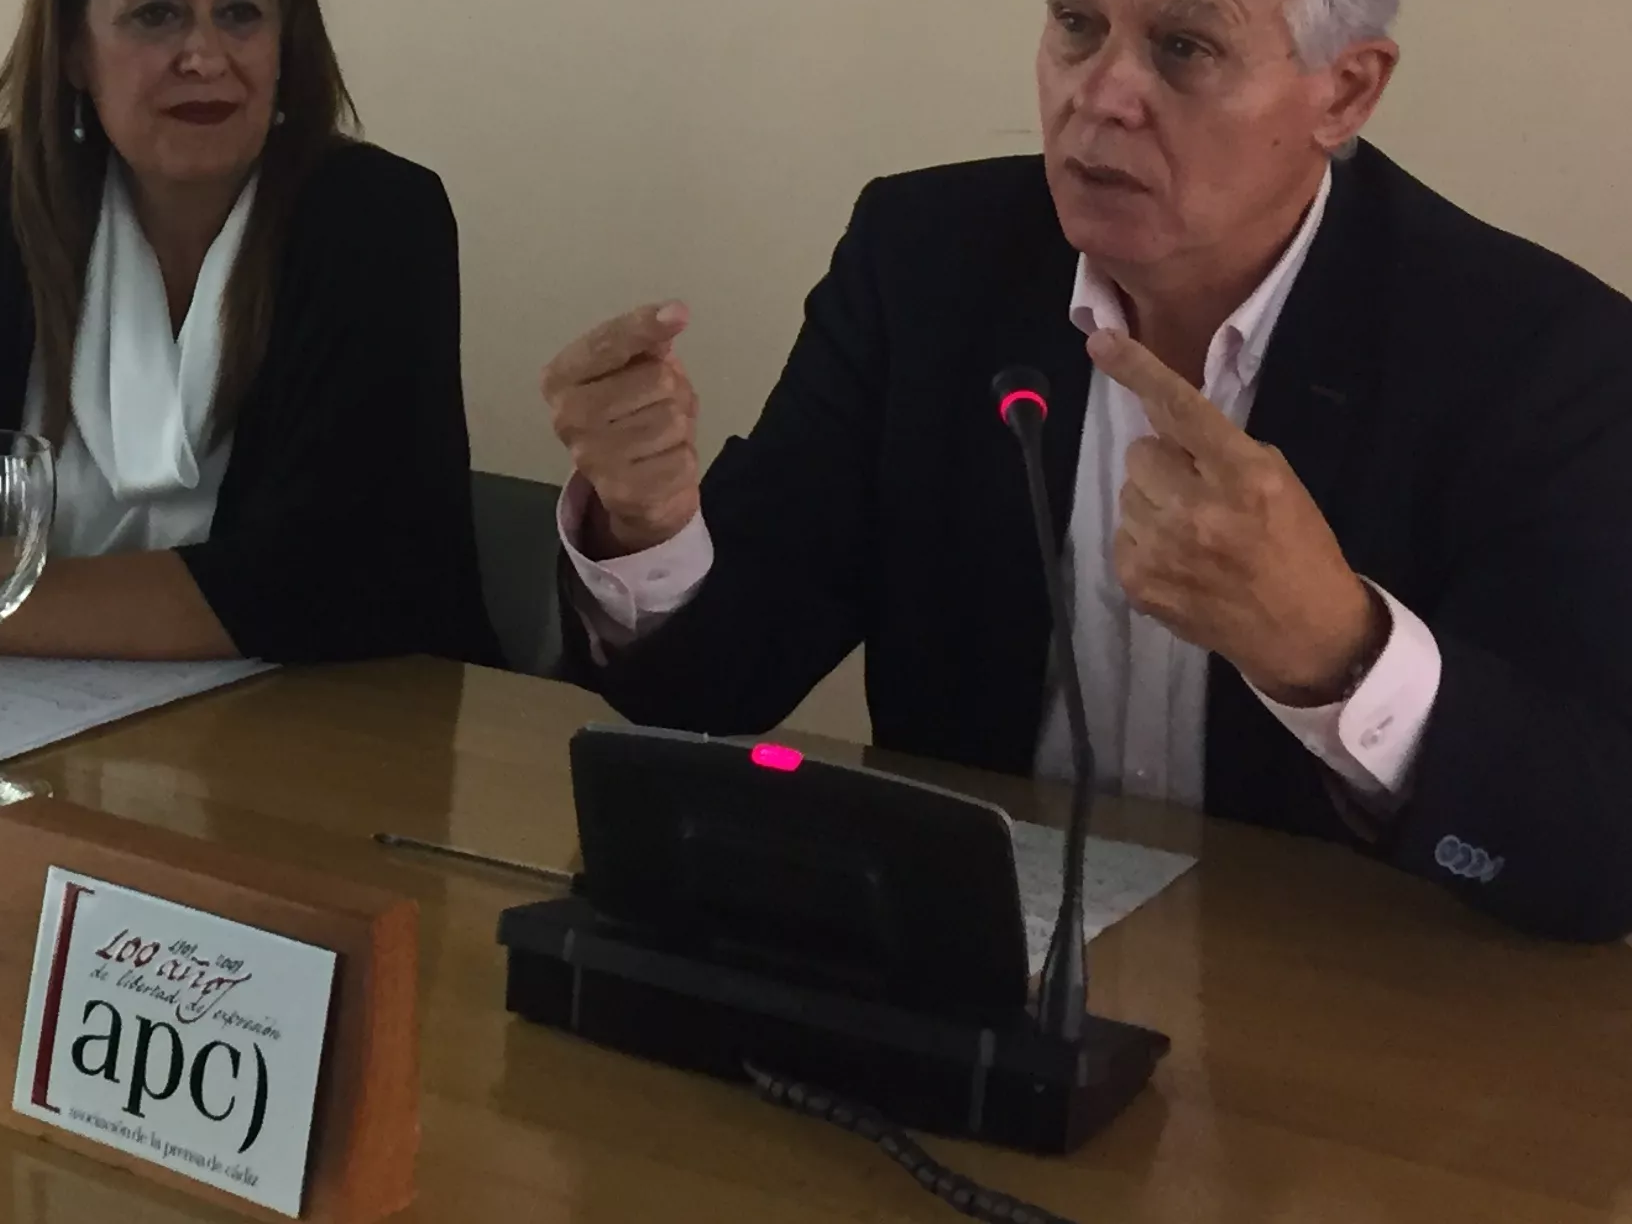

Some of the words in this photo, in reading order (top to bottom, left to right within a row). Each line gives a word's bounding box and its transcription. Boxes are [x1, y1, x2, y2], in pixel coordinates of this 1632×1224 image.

[95, 928, 161, 969] 100
[89, 963, 109, 982] de
[116, 969, 181, 1006] libertad
[131, 1126, 149, 1144] de
[150, 1131, 162, 1150] la
[162, 1139, 206, 1168] prensa
[206, 1154, 223, 1173] de
